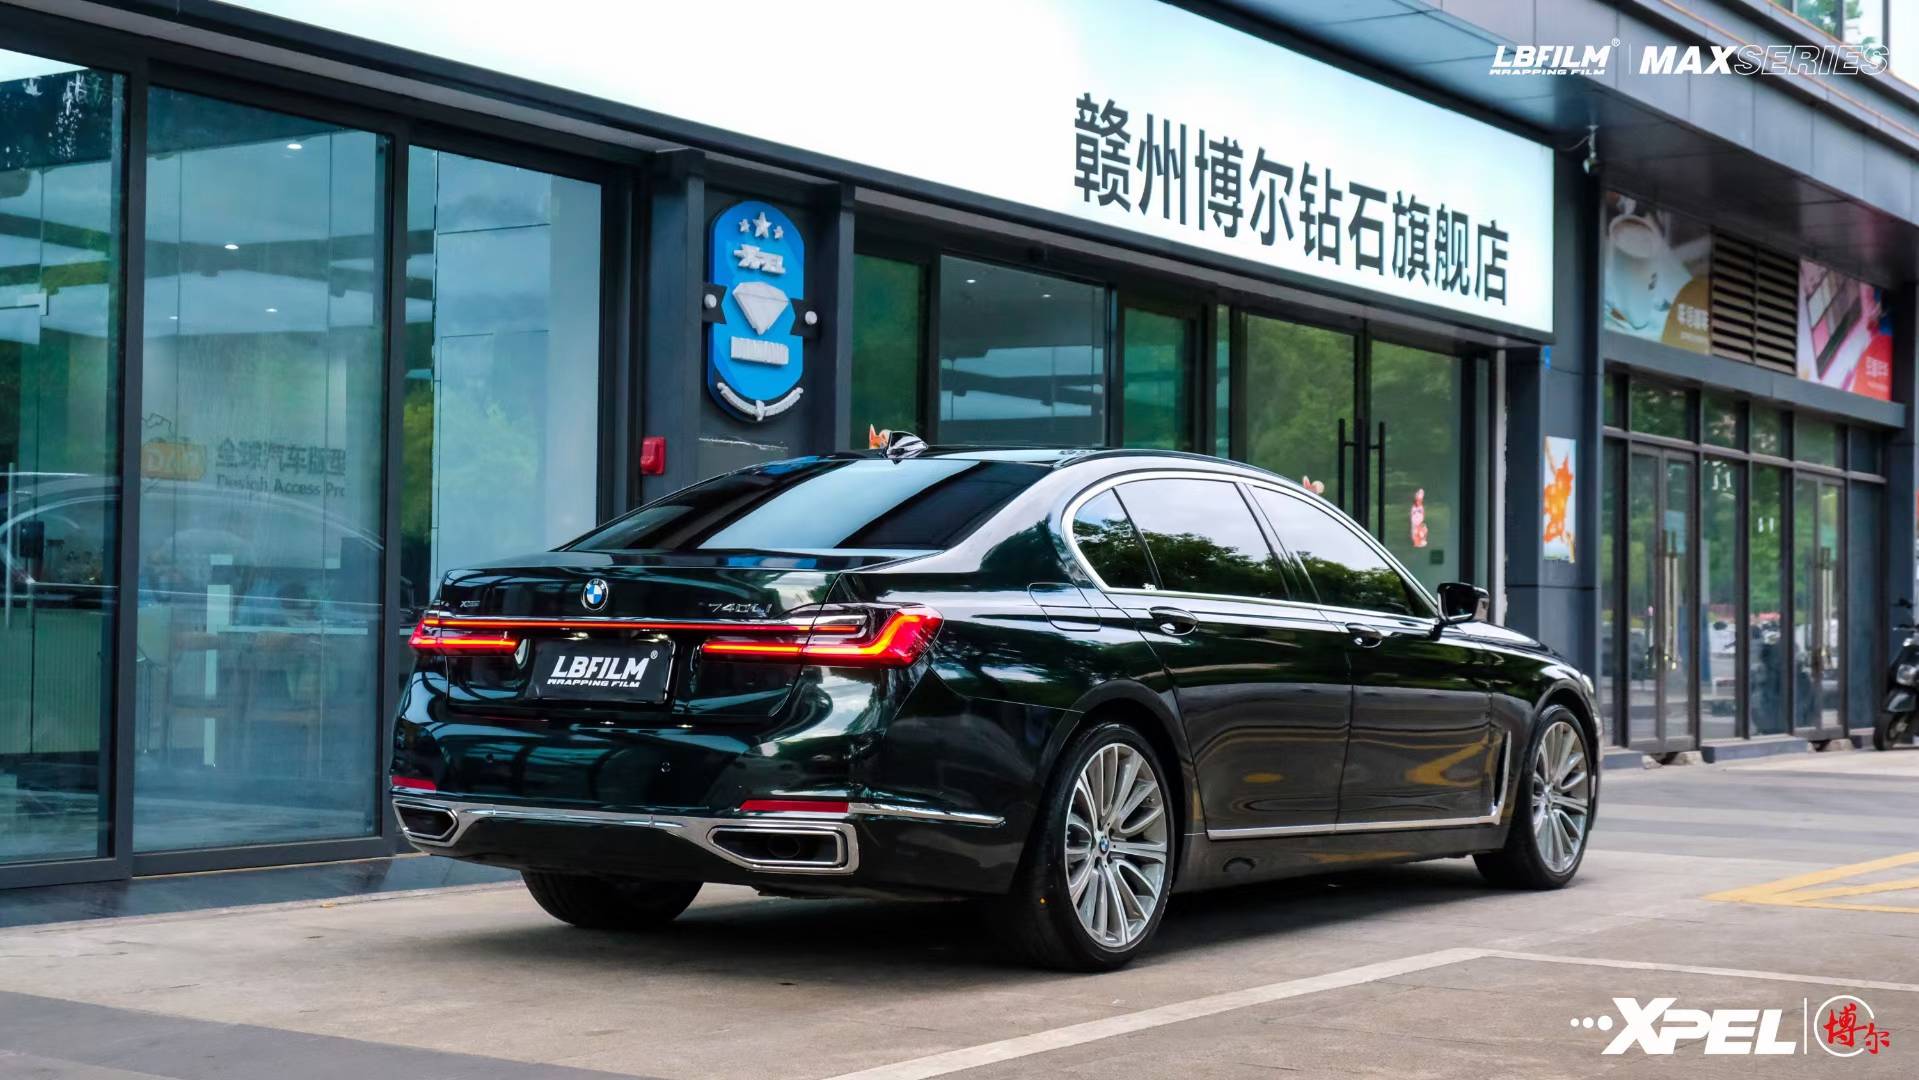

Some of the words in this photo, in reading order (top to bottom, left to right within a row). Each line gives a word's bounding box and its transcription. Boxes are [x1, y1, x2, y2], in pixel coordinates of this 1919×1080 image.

[1074, 92, 1510, 306] 赣州博尔钻石旗舰店
[274, 479, 321, 496] Access
[547, 678, 609, 687] WRAPPING
[611, 680, 641, 688] FILM
